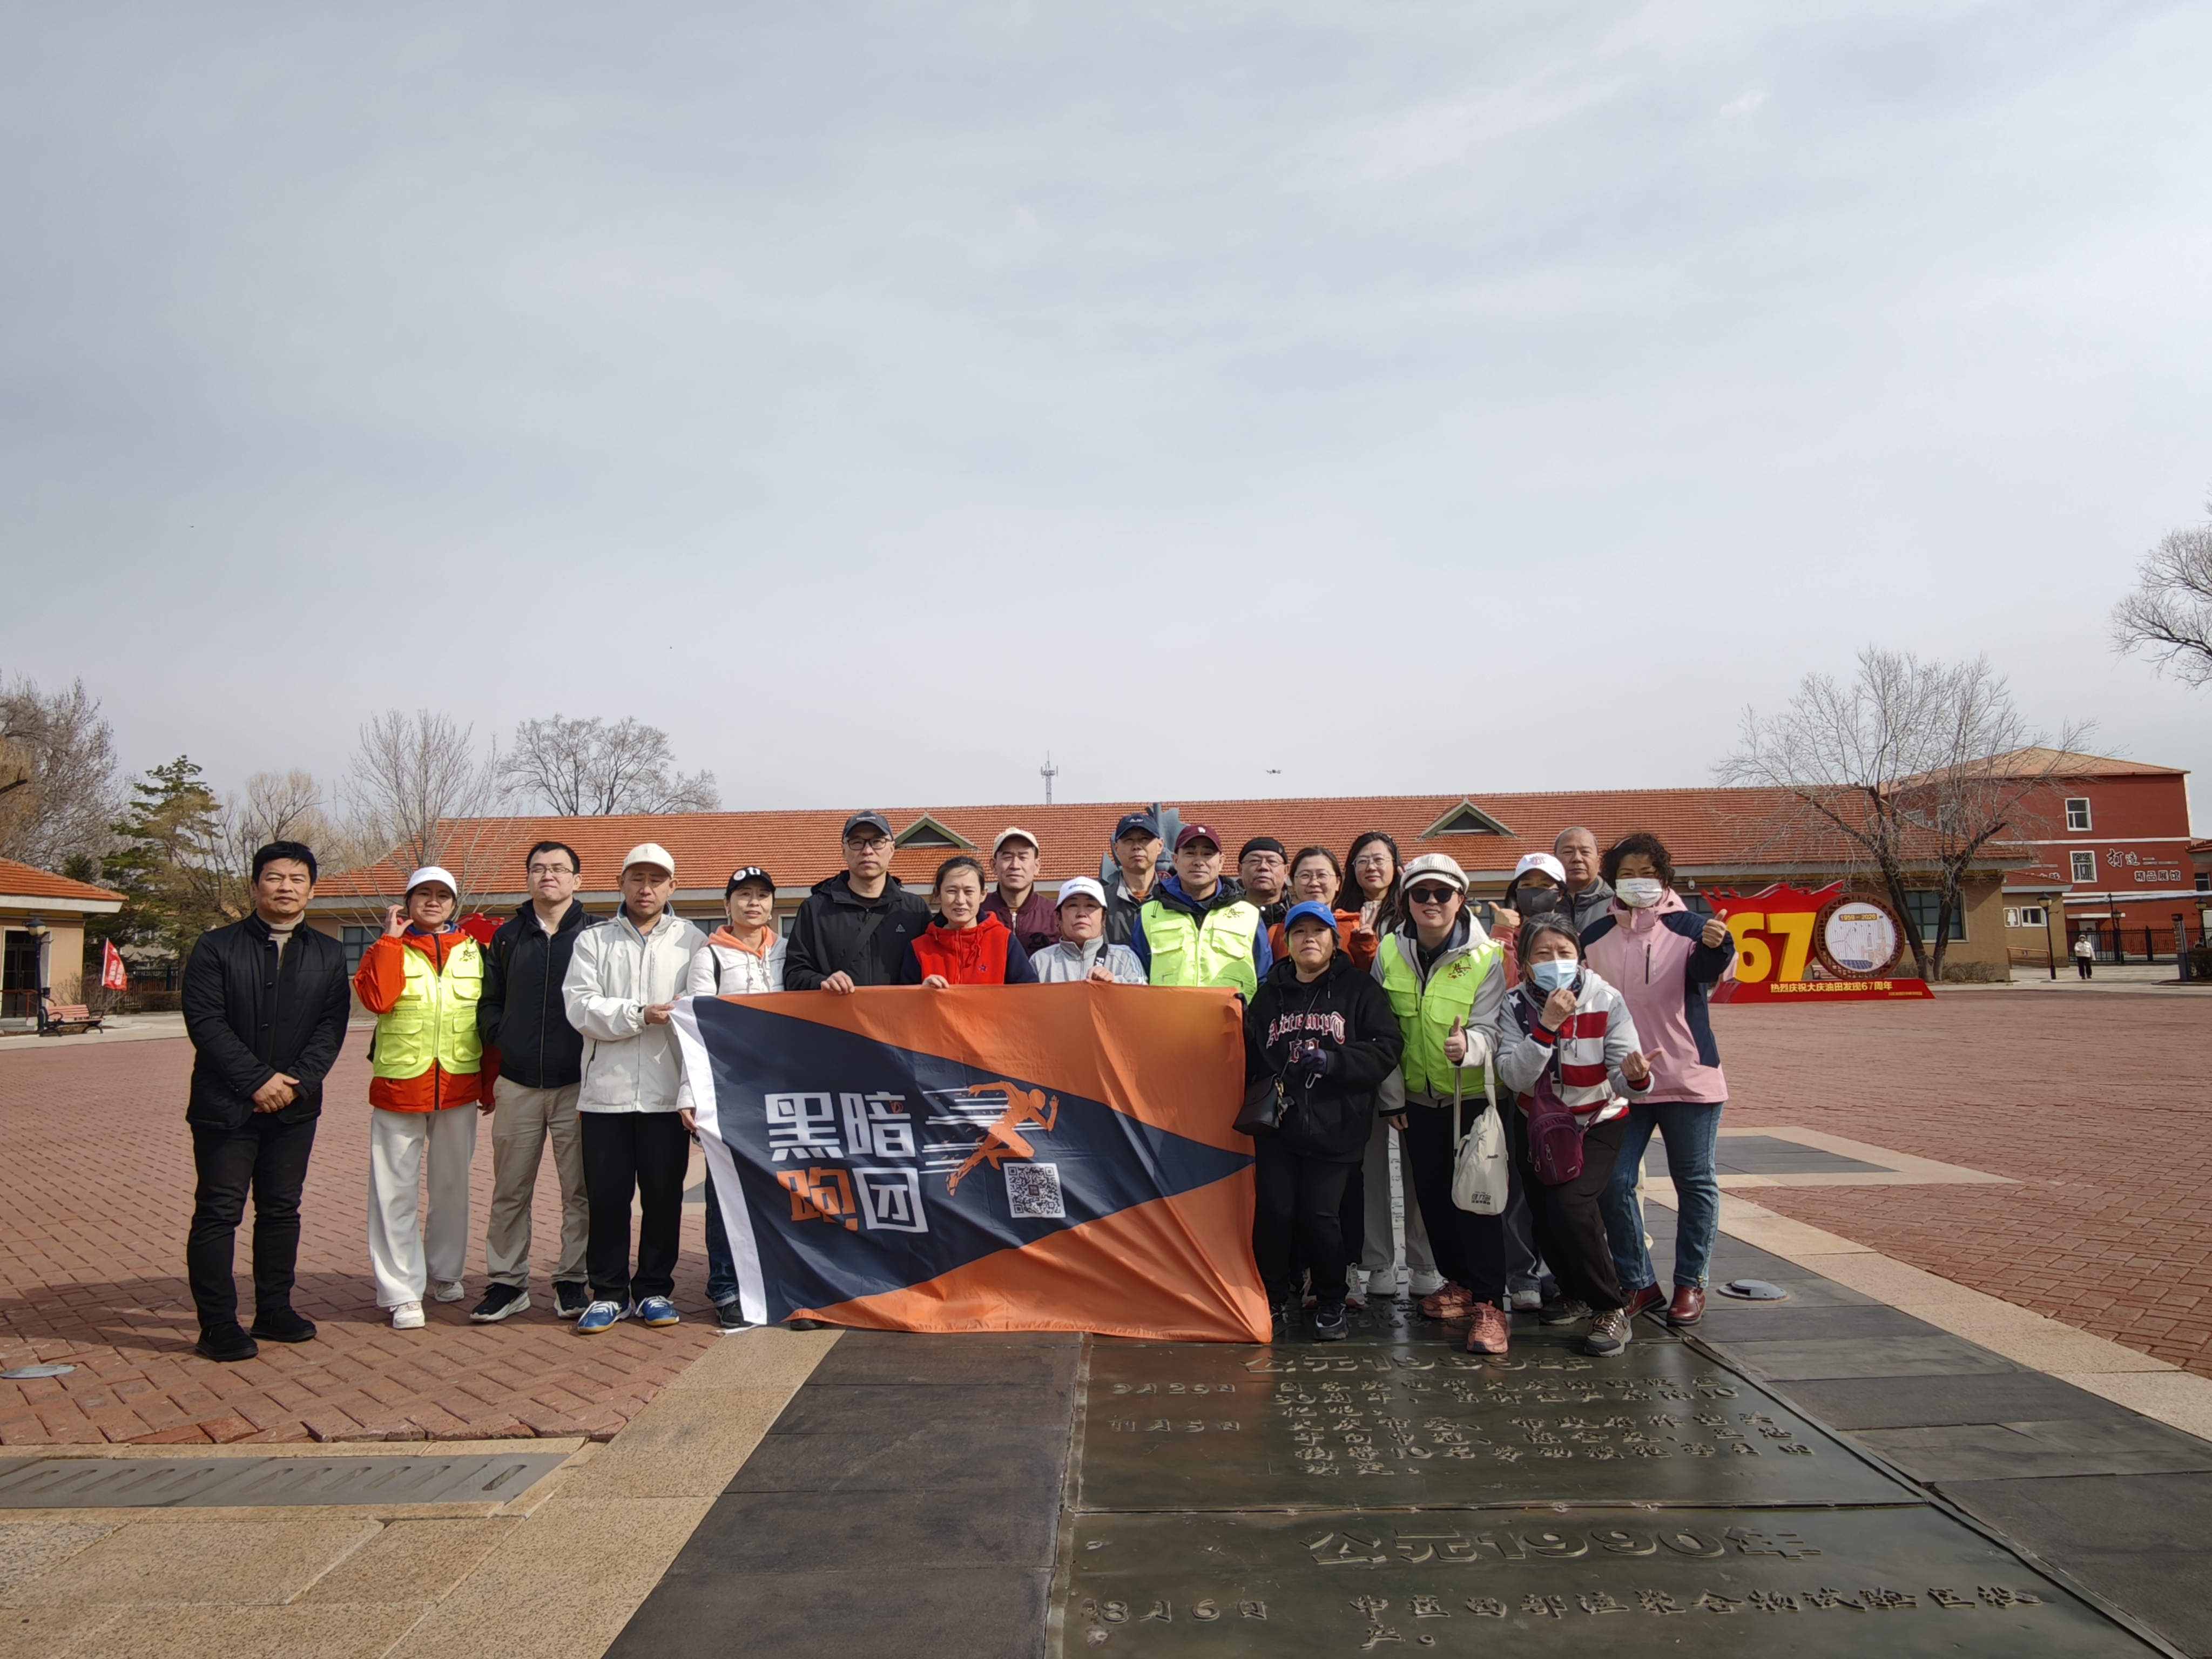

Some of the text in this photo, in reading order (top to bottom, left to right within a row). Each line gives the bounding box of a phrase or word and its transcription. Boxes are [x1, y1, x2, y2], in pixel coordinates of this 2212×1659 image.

[2107, 848, 2140, 867] 打造
[2134, 869, 2181, 881] 精品展馆
[1725, 912, 1817, 983] 67
[1770, 981, 1893, 993] 热烈庆祝大庆油田发现67周年
[764, 1090, 916, 1162] 黑暗
[775, 1166, 928, 1233] 跑团
[1239, 1353, 1593, 1373] 公元1989年
[1300, 1527, 1823, 1565] 公元1990年
[1102, 1599, 1267, 1623] 8月6日
